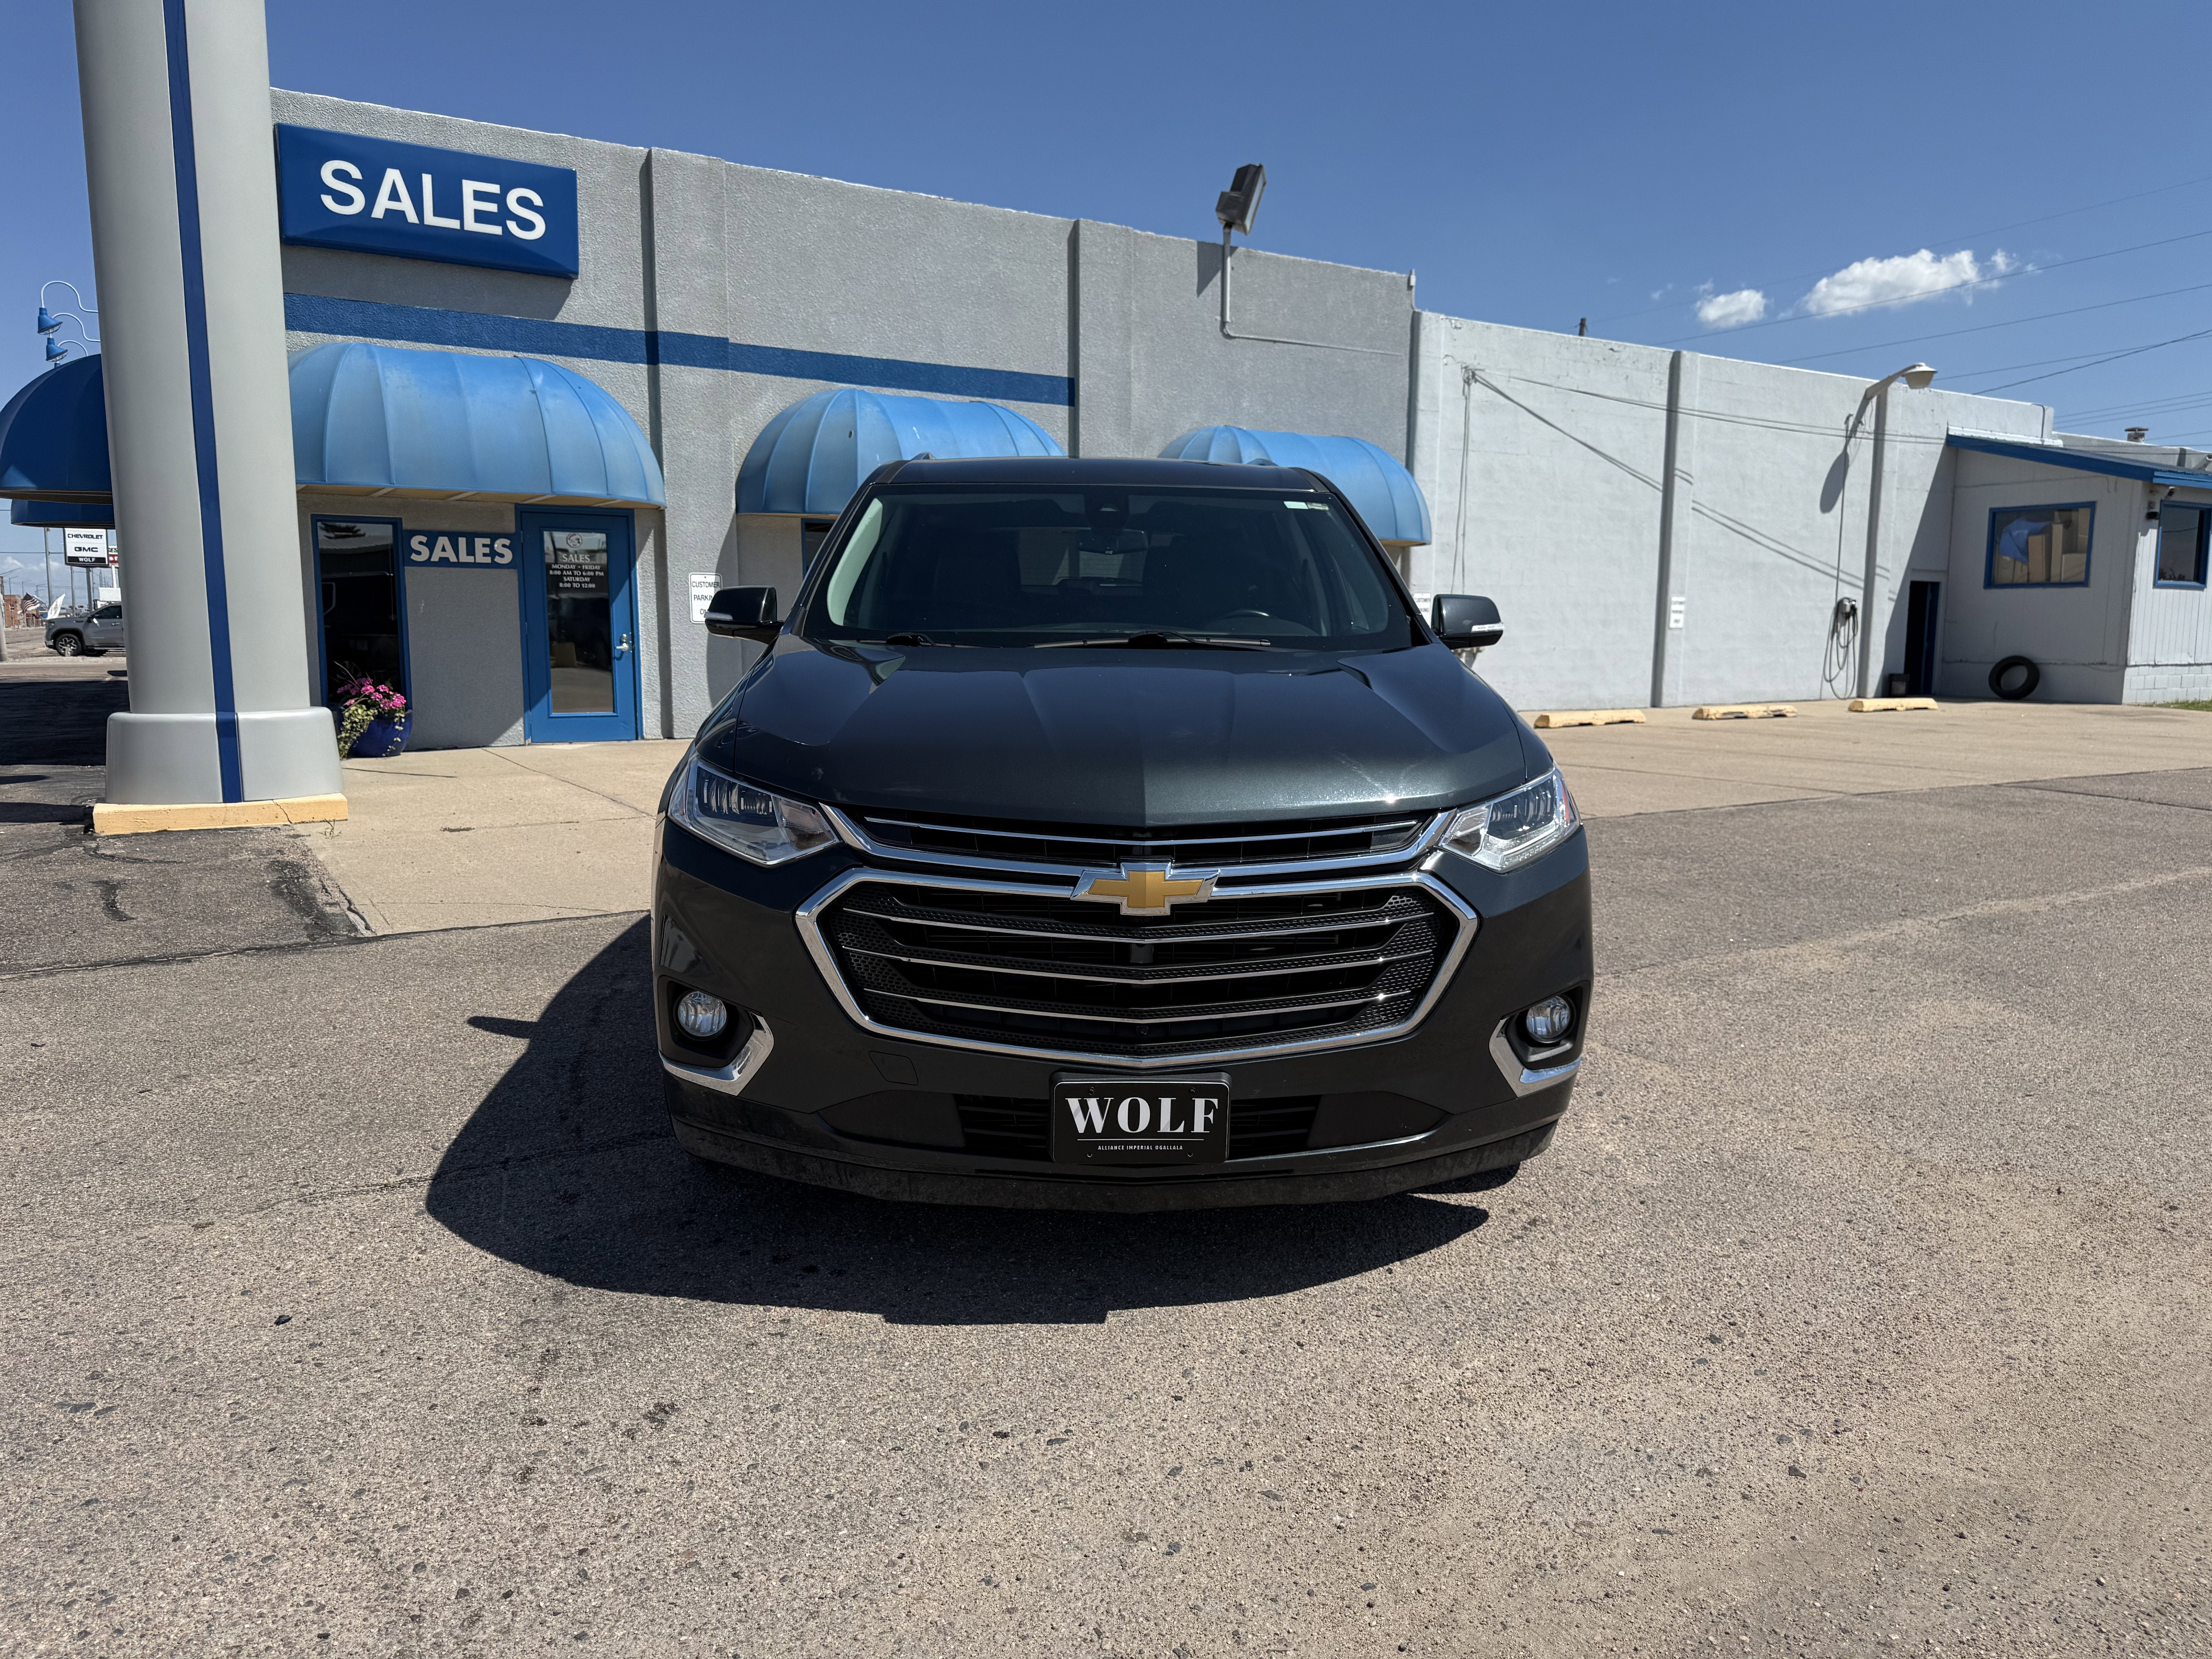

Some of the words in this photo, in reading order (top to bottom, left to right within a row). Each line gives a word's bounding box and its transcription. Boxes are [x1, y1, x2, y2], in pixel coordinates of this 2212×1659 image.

[320, 160, 546, 240] SALES
[410, 535, 513, 564] SALES
[562, 554, 591, 562] SALES
[1065, 1097, 1218, 1133] WOLF
